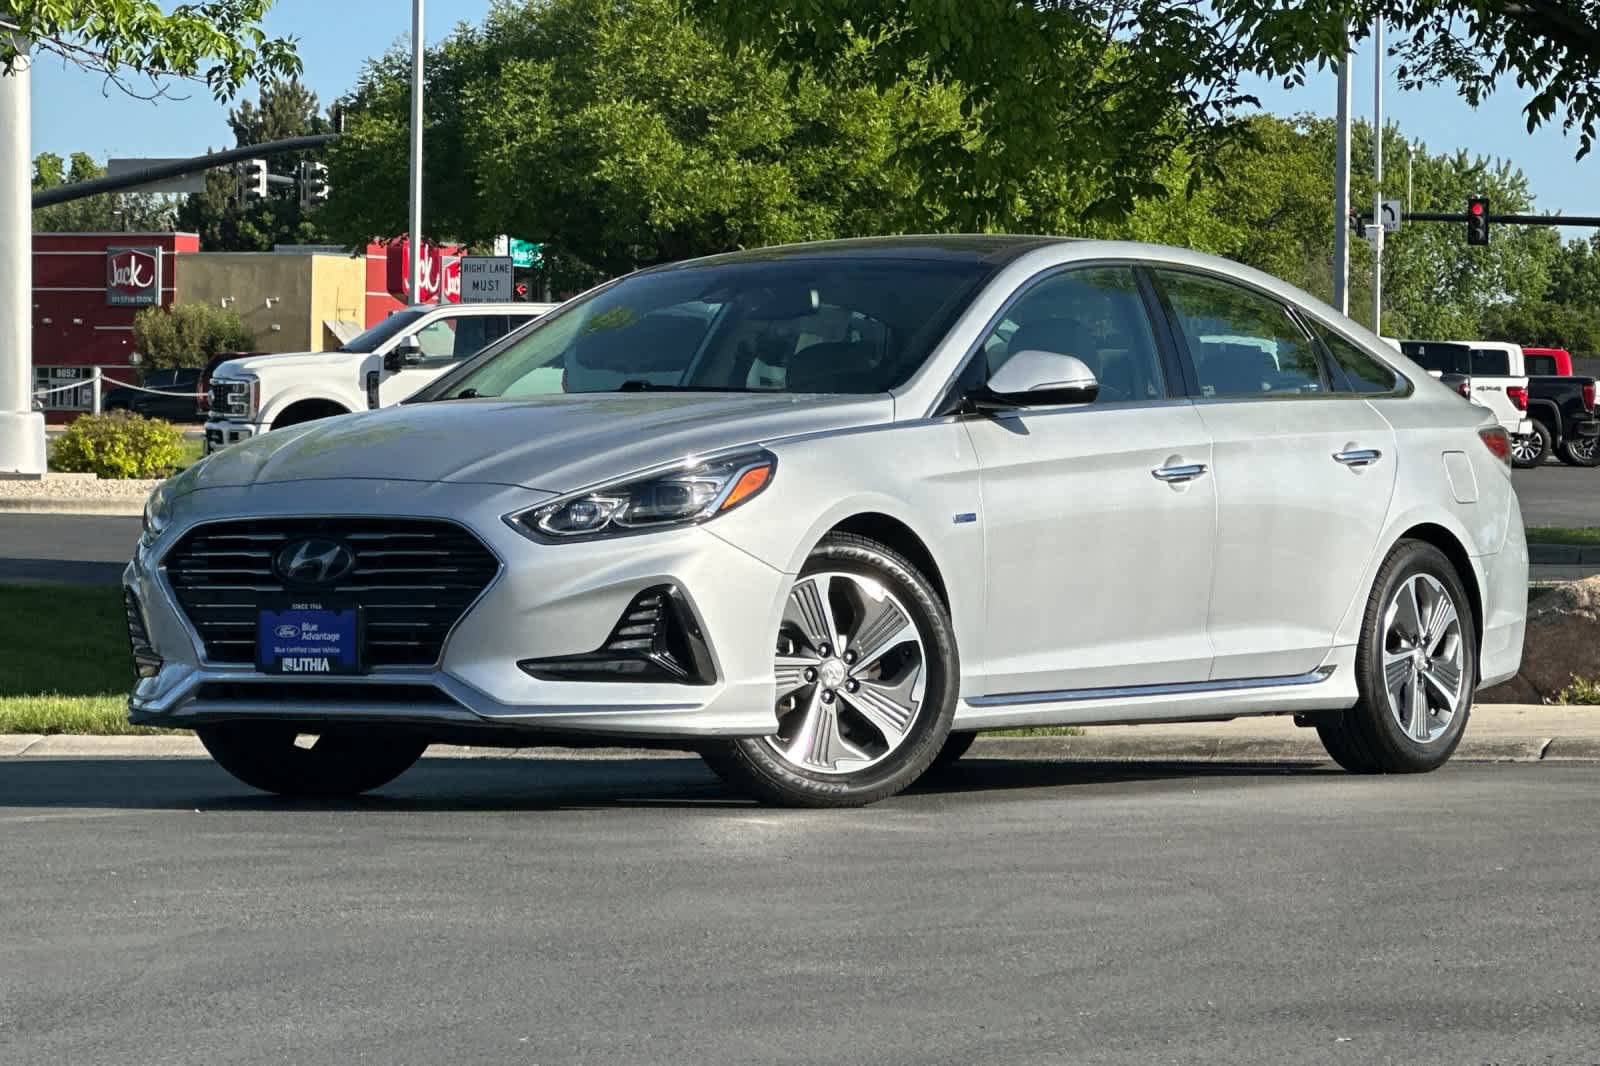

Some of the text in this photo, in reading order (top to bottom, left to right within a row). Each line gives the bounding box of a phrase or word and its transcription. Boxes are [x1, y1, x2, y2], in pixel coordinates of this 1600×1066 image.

[110, 255, 154, 288] Jack
[464, 263, 510, 274] RIGHT LANE
[472, 279, 499, 291] MUST
[279, 626, 297, 637] Ford
[302, 622, 318, 631] Blue
[302, 632, 340, 642] Advantage
[294, 657, 330, 671] LITHIA
